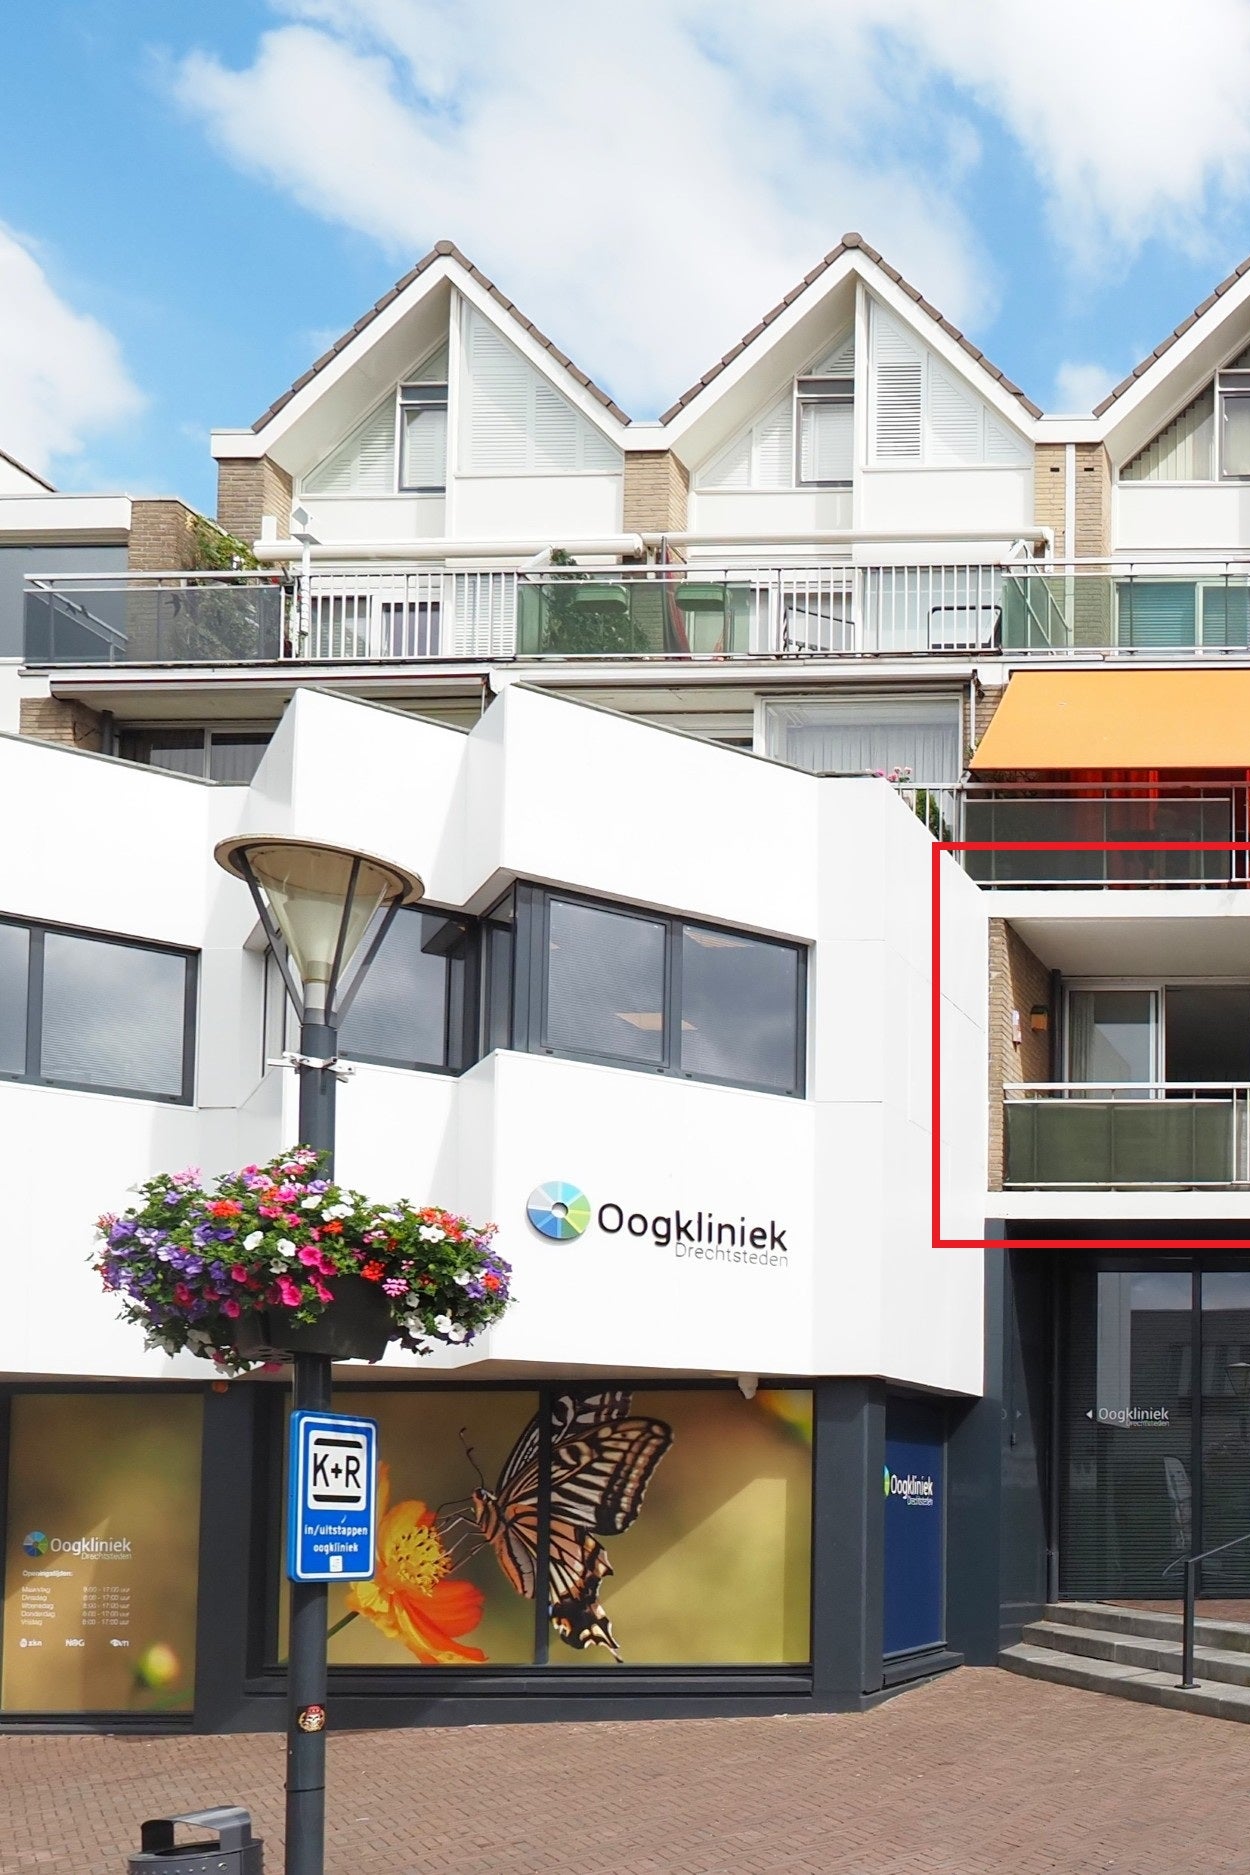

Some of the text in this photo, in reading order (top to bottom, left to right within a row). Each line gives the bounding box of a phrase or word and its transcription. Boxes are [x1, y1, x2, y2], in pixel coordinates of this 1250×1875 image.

[598, 1203, 788, 1252] Oogkliniek
[675, 1242, 789, 1268] Drechtsteden
[1098, 1407, 1169, 1423] Oogkliniek
[313, 1453, 362, 1488] K+R
[890, 1474, 934, 1500] Oogkliniek
[304, 1523, 369, 1537] in/uitstappen
[50, 1537, 132, 1556] Oogkliniek
[313, 1542, 359, 1555] oogkliniek
